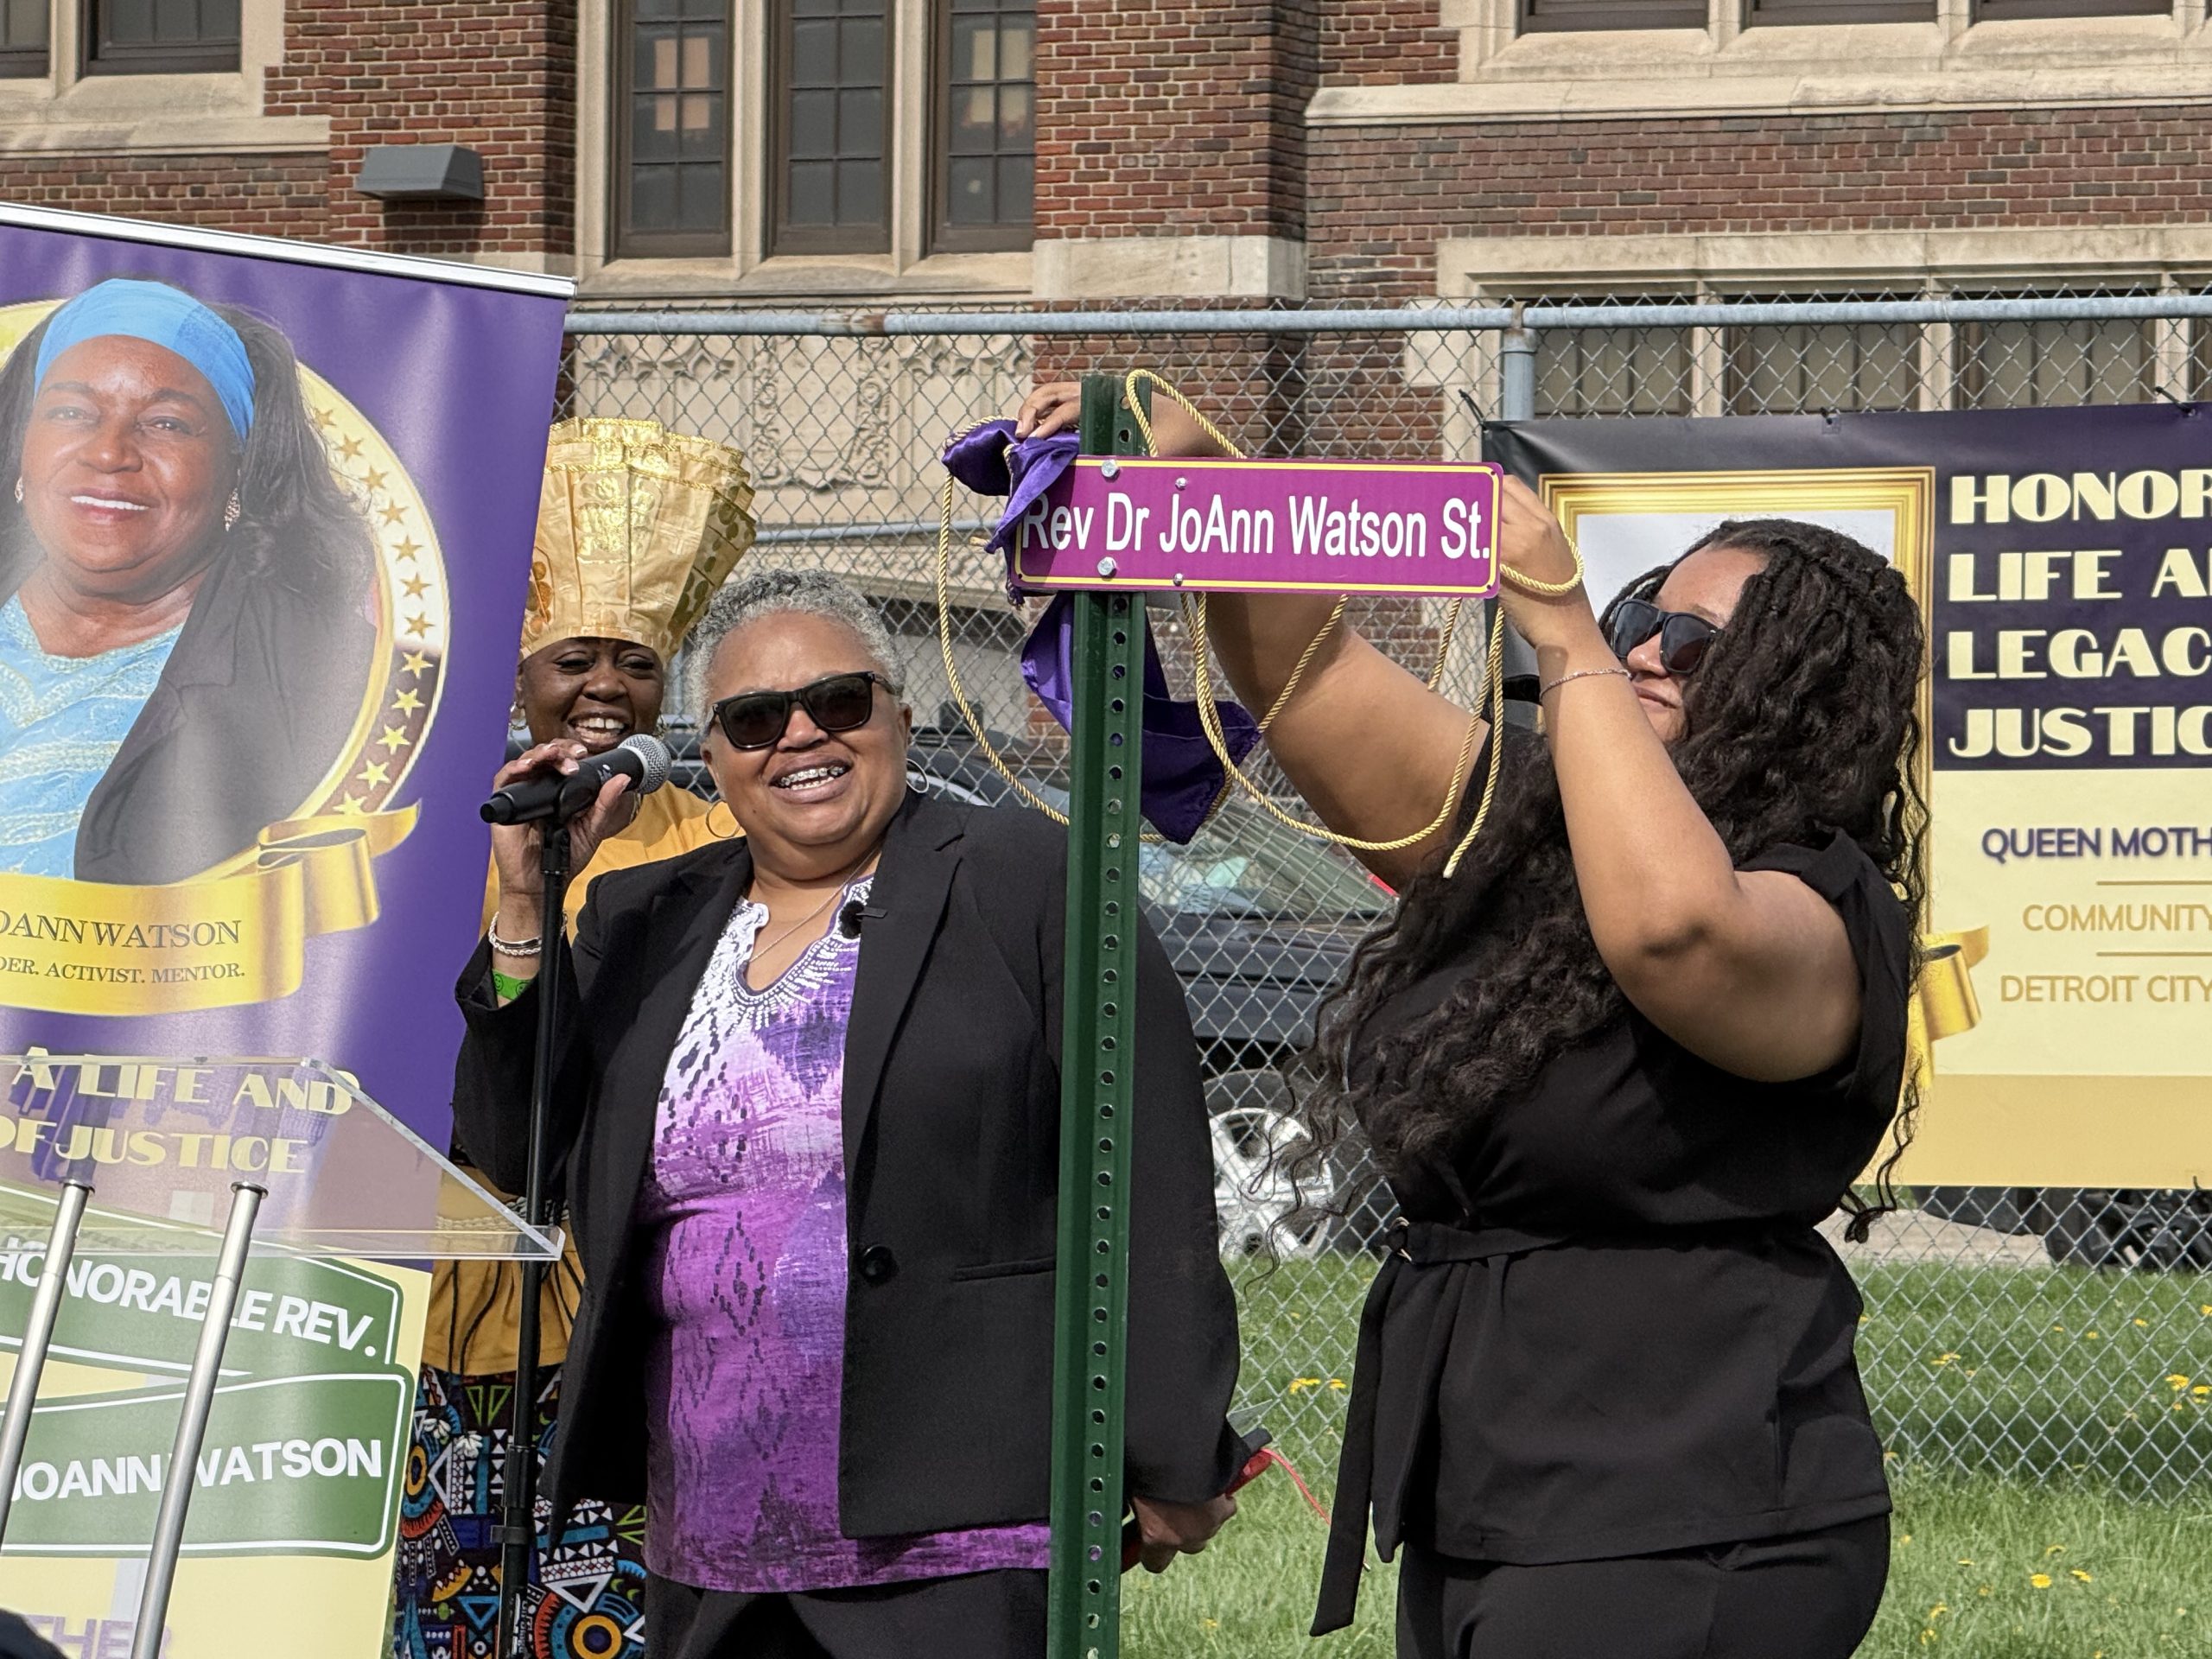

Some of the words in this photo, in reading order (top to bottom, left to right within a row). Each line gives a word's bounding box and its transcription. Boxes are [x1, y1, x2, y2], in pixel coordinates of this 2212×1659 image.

[1950, 469, 2212, 524] HONOR
[1021, 492, 1095, 550] Rev
[1105, 492, 1150, 551] Dr
[1159, 493, 1274, 554] JoAnn
[1288, 494, 1427, 558] Watson
[1440, 497, 1491, 560] St.
[1948, 550, 2123, 601] LIFE
[2151, 548, 2212, 598] A
[1948, 626, 2212, 680] LEGAC
[1948, 705, 2212, 758] JUSTIC
[1981, 827, 2102, 864] QUEEN
[2111, 826, 2212, 858] MOTH
[91, 919, 242, 949] WATSON
[45, 962, 145, 983] ACTIVIST.
[151, 963, 245, 983] MENTOR.
[2000, 975, 2140, 1002] DETROIT
[2146, 975, 2212, 1002] CITY
[12, 1046, 56, 1090] A
[78, 1053, 214, 1103] LIFE
[232, 1069, 360, 1116] AND
[55, 1125, 308, 1173] JUSTICE
[0, 1236, 273, 1332] HONORABE
[272, 1294, 377, 1357] REV.
